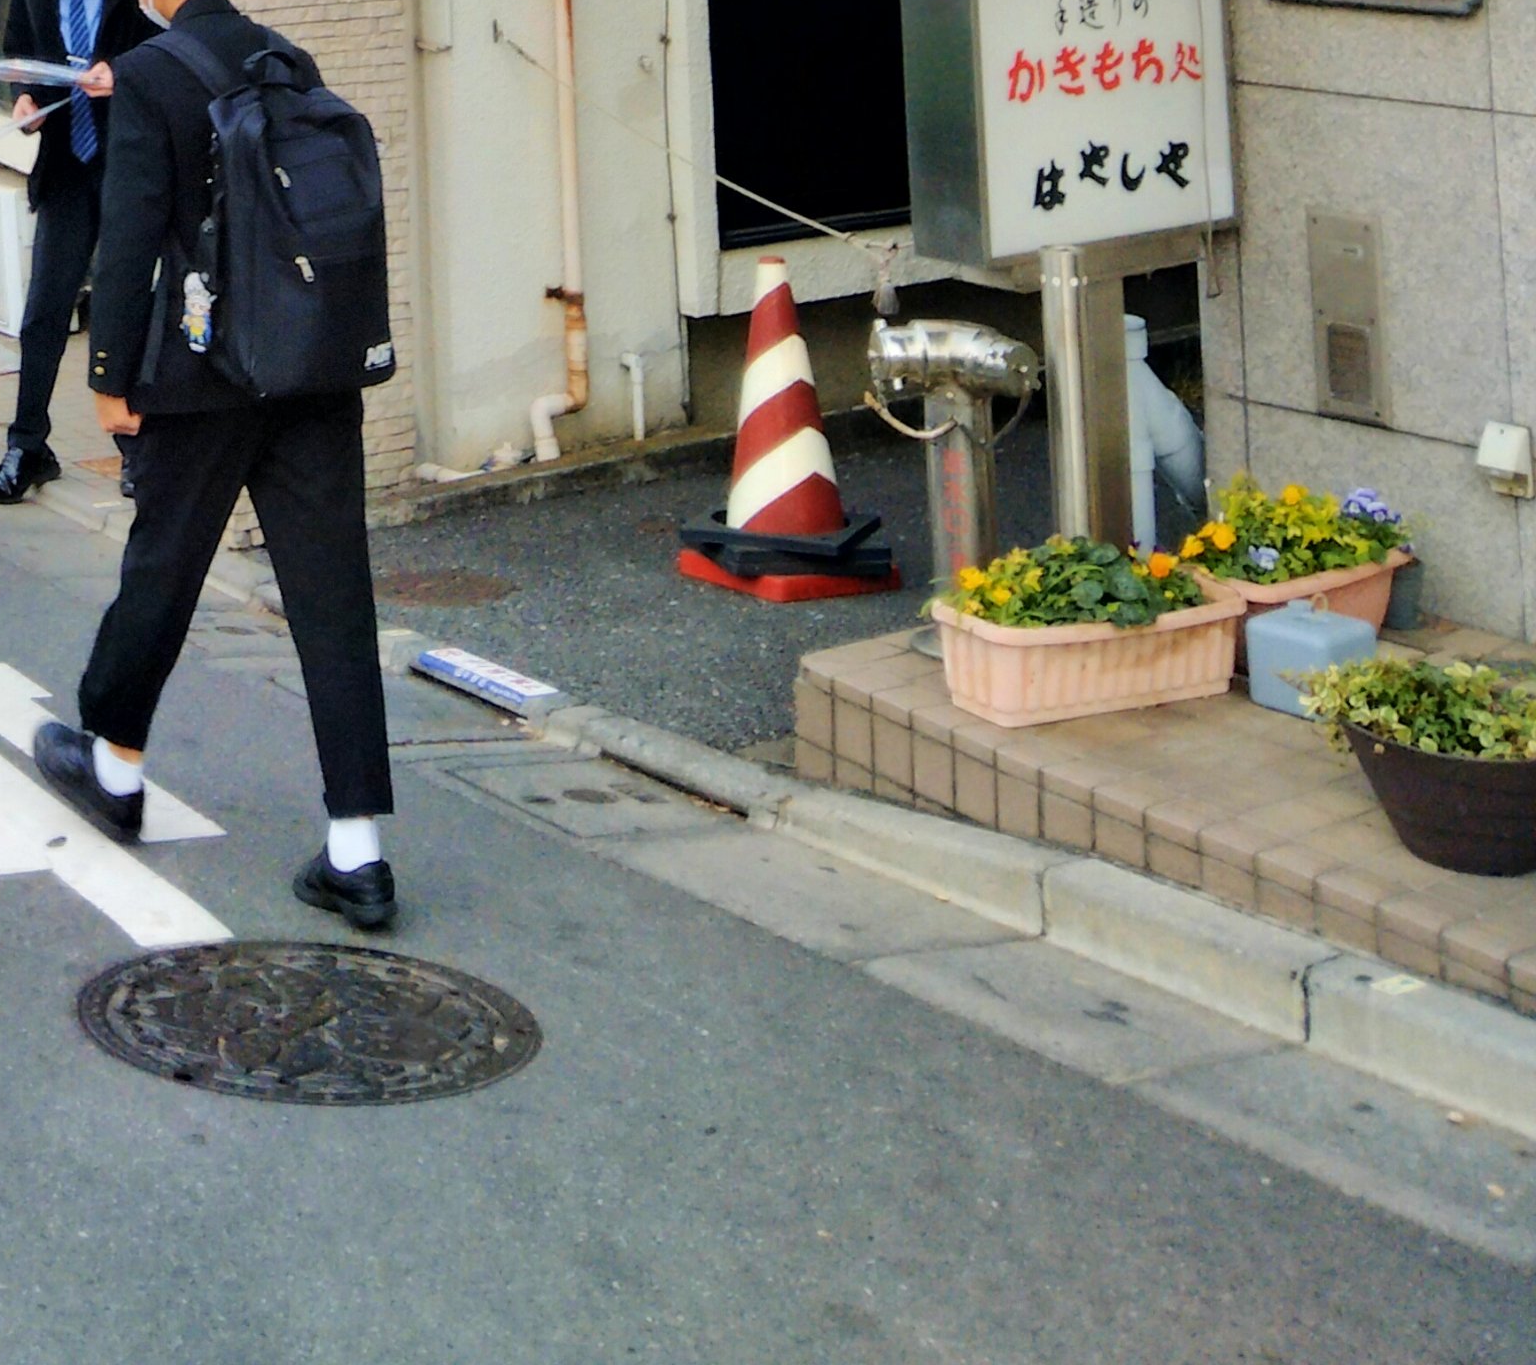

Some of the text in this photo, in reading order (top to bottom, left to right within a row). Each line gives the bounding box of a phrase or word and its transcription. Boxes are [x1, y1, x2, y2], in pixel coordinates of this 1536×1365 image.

[1006, 37, 1205, 104] かきもち処
[1032, 139, 1192, 212] はやしや
